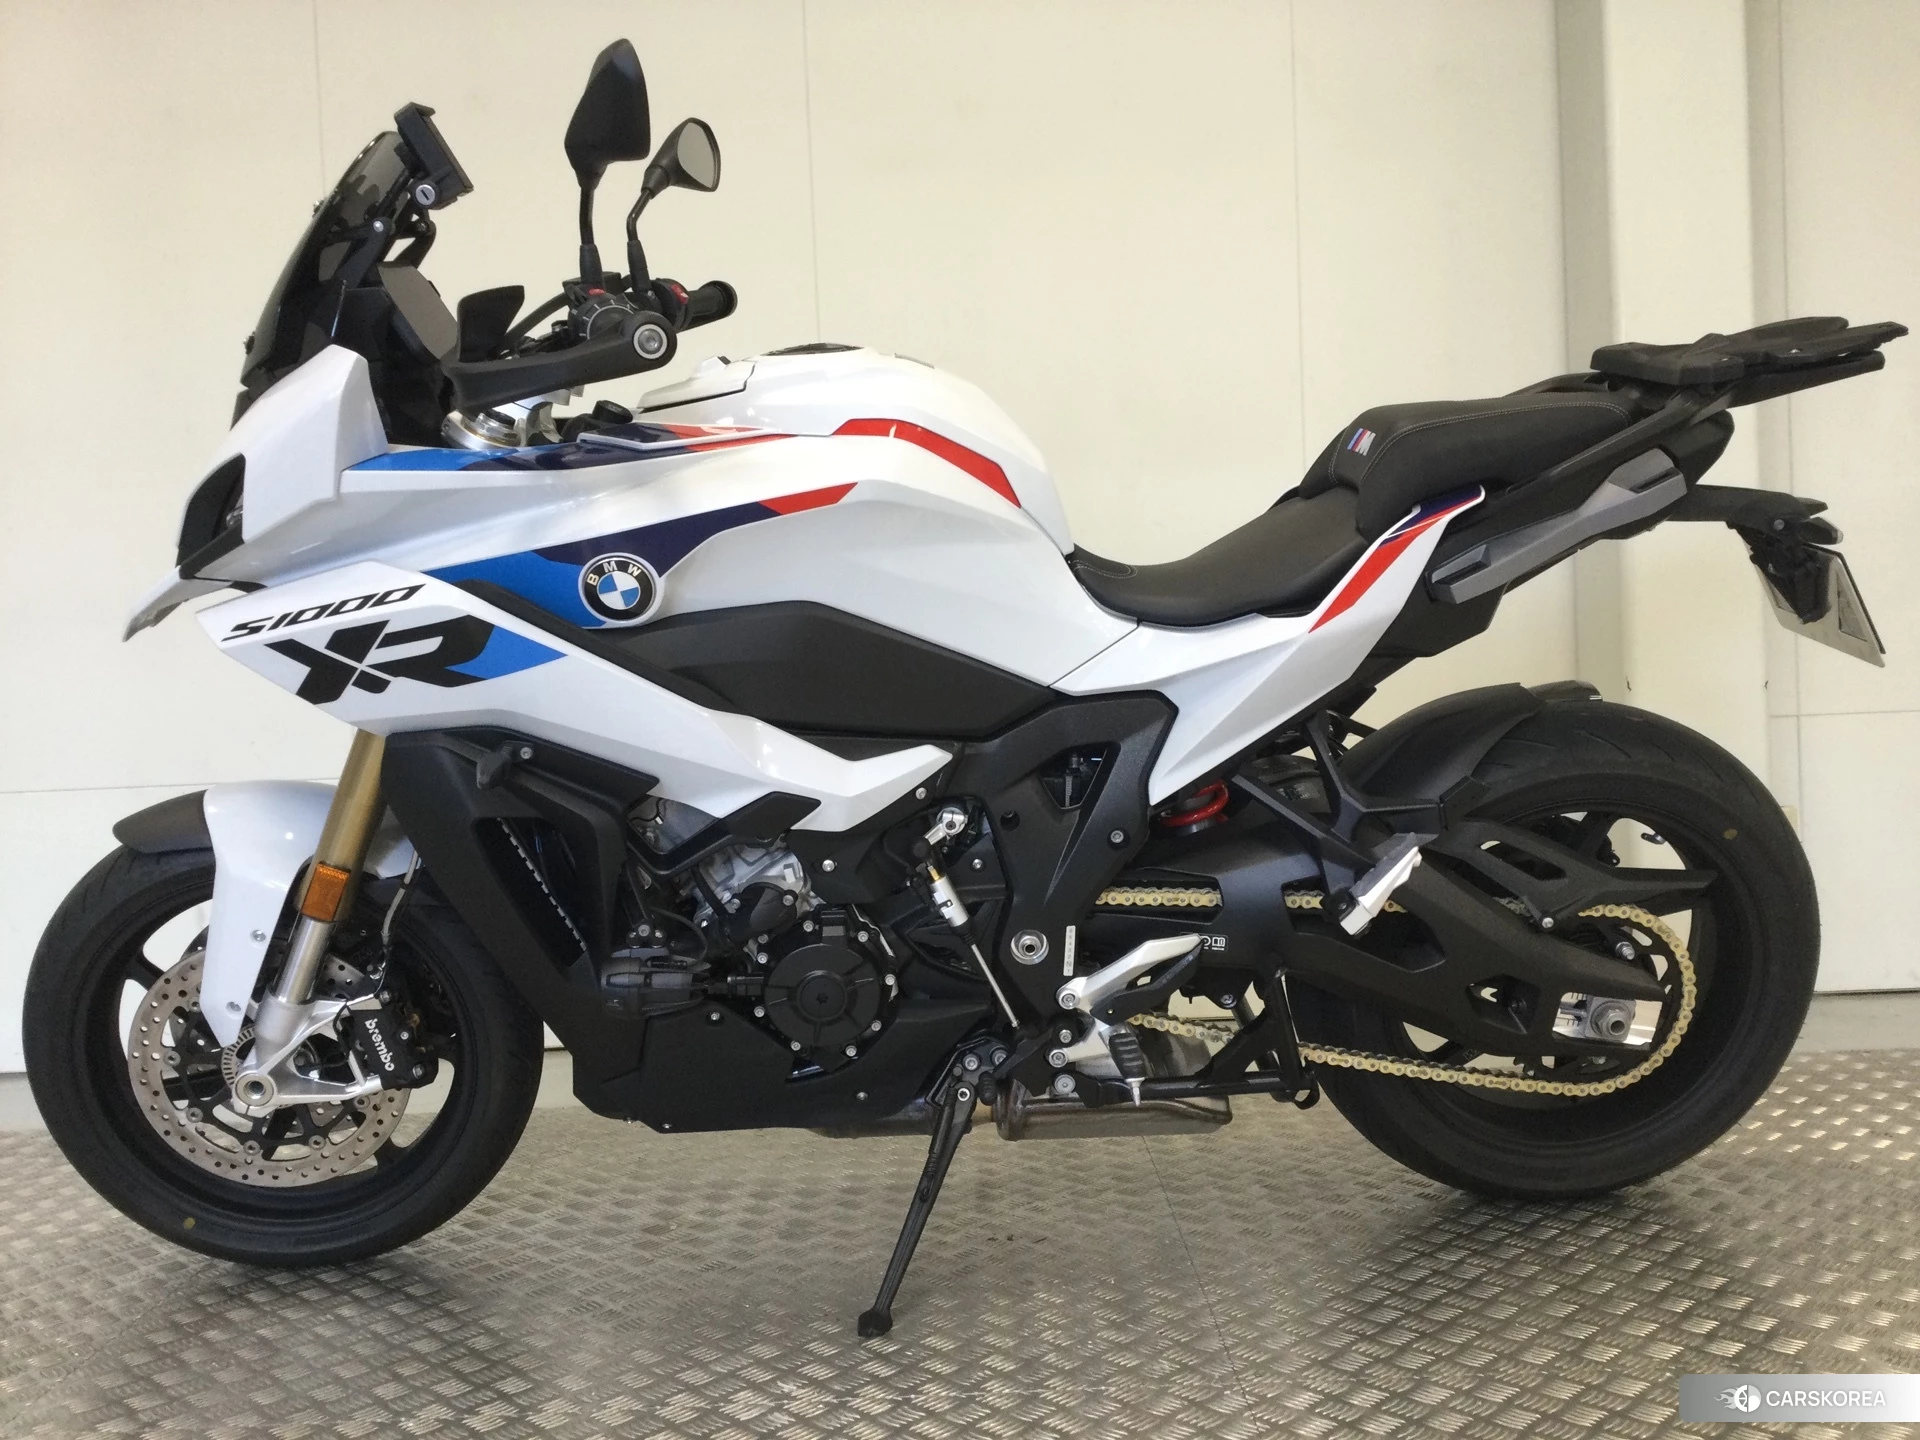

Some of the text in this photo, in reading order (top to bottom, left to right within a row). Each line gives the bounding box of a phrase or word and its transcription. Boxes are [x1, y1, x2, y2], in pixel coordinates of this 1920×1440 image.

[586, 560, 642, 586] BMW
[220, 584, 427, 641] S1000
[263, 614, 495, 705] XR
[364, 1018, 395, 1071] brembo
